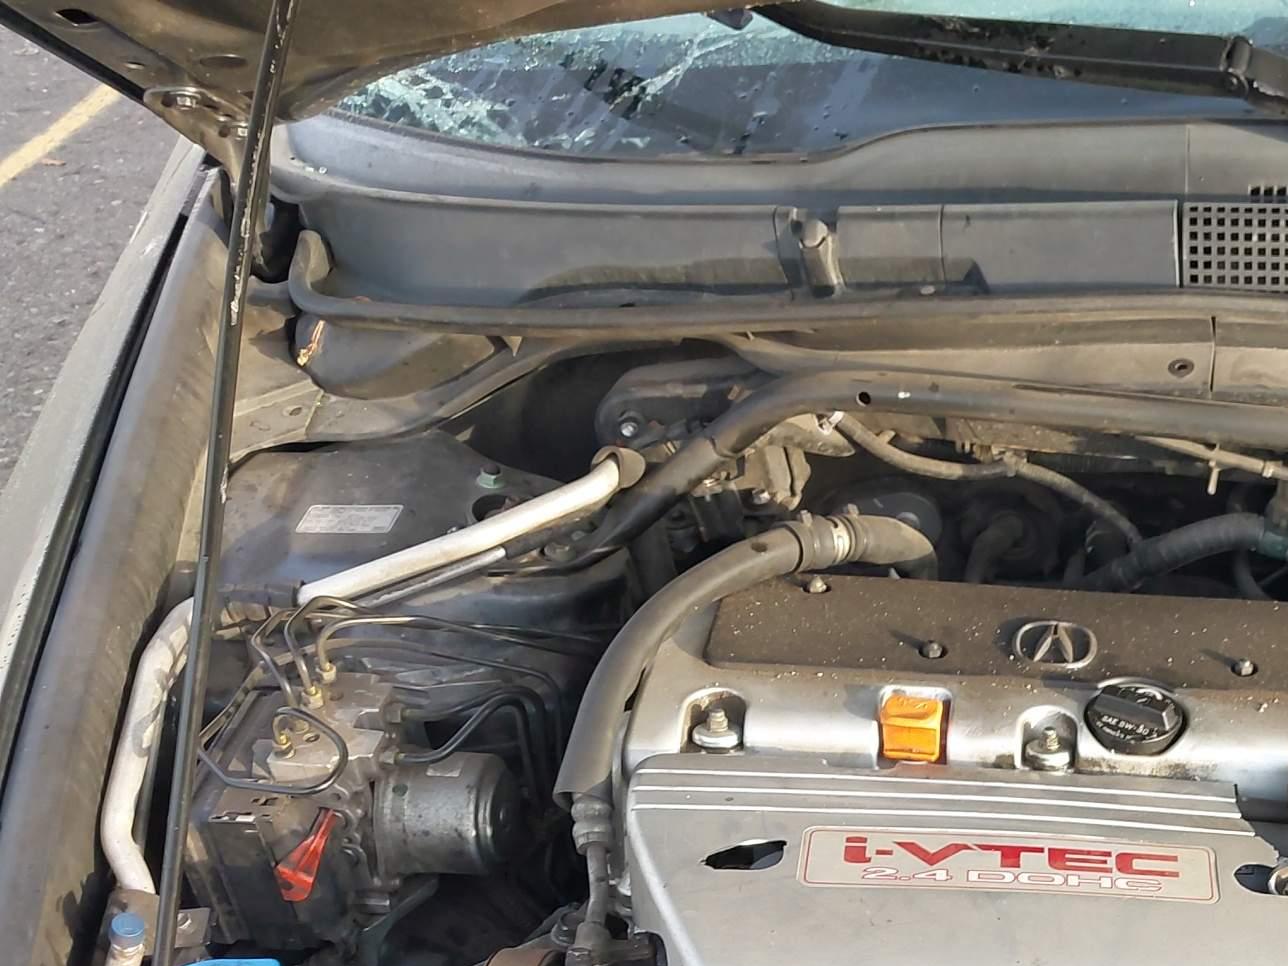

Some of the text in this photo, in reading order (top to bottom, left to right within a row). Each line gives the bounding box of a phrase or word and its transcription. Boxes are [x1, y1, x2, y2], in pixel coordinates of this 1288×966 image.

[842, 835, 1180, 878] i-VTEC
[861, 866, 1164, 893] 2.4 DOHC
